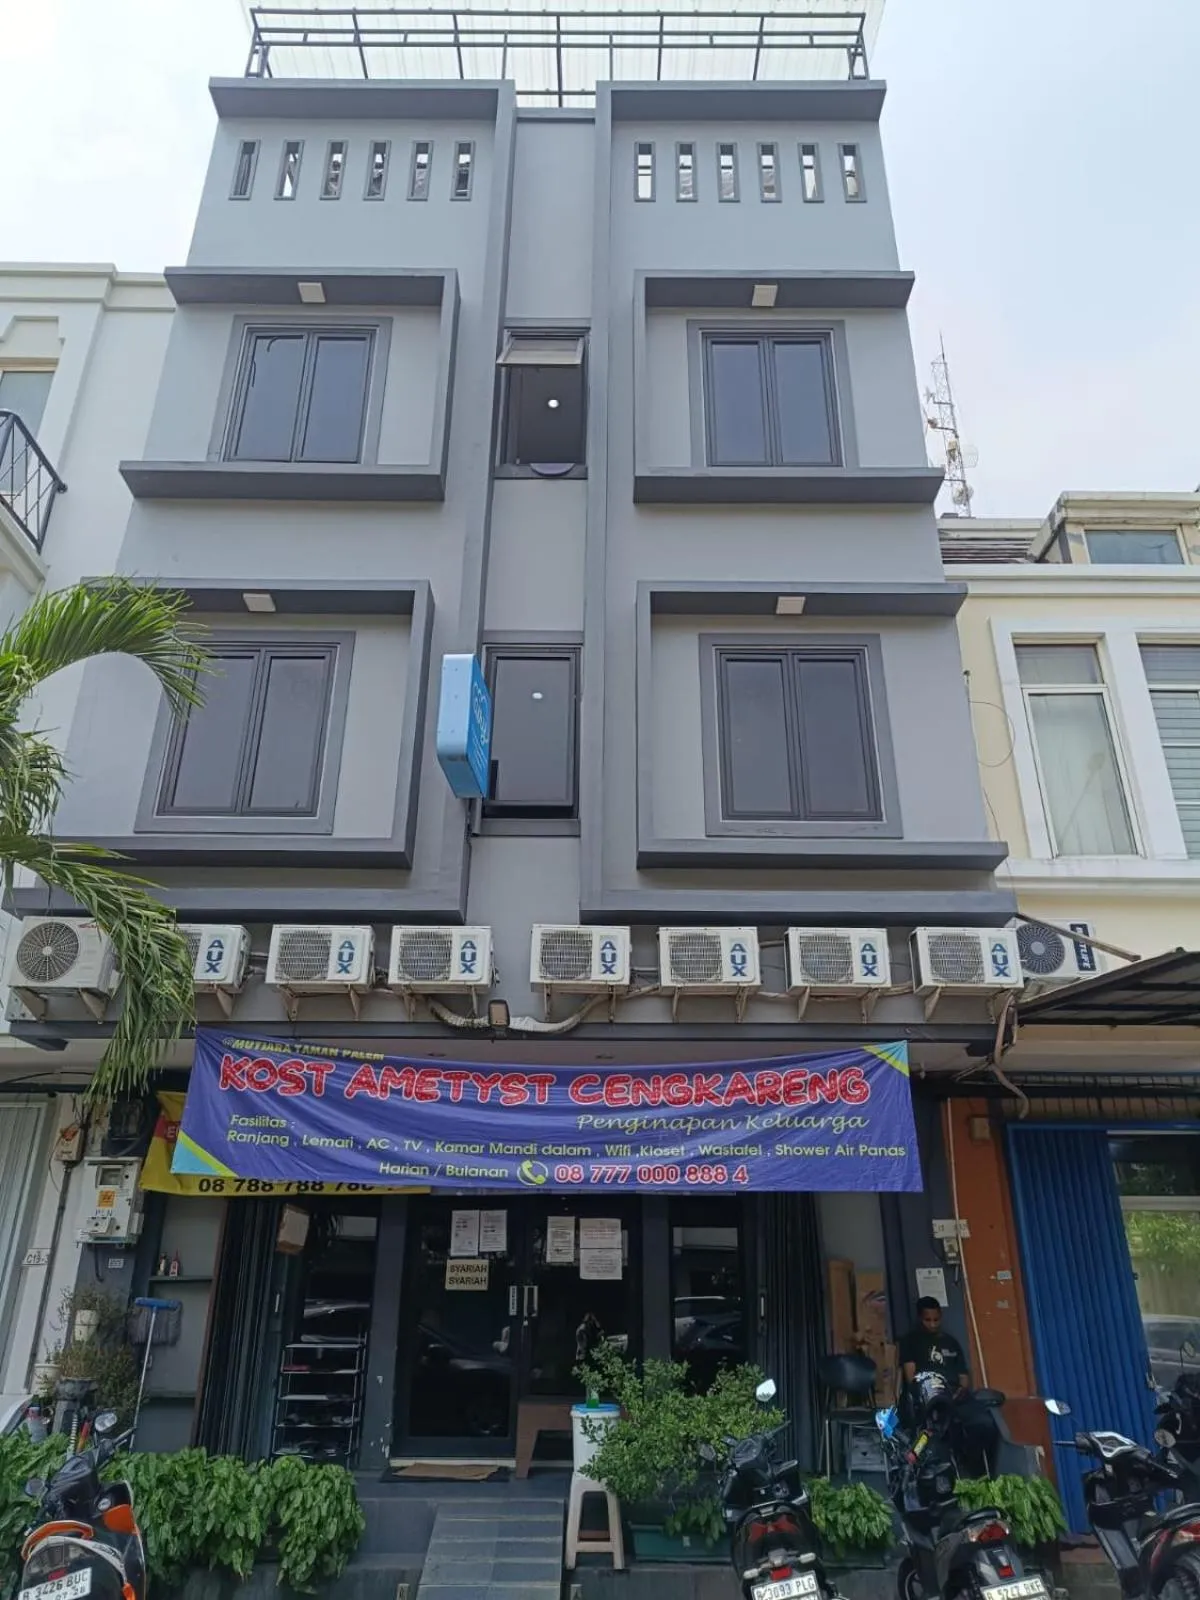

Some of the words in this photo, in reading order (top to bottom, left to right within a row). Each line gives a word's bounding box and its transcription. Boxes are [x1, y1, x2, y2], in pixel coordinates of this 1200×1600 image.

[204, 939, 225, 973] AUX
[337, 939, 354, 975] AUX
[459, 939, 477, 975] AUX
[600, 939, 617, 977] AUX
[729, 941, 749, 977] AUX
[859, 942, 879, 978] AUX
[992, 942, 1012, 979] AUX
[219, 1054, 336, 1097] KOST
[344, 1063, 557, 1106] AMETYST
[568, 1067, 871, 1107] CENGKARENG
[230, 1114, 287, 1129] Fasilitas
[576, 1113, 739, 1136] Penginapan
[745, 1112, 870, 1135] Keluarga
[227, 1129, 290, 1148] Ranjang
[302, 1133, 354, 1149] Lemari
[366, 1138, 390, 1150] AC
[404, 1140, 423, 1151] TV
[434, 1140, 485, 1154] Kamar
[489, 1143, 538, 1155] Mandi
[541, 1144, 592, 1156] dalam
[699, 1143, 762, 1157] Wastafel
[775, 1143, 830, 1157] Shower
[834, 1143, 855, 1157] Air
[858, 1144, 906, 1157] Panas
[199, 1178, 225, 1193] 08
[233, 1179, 274, 1193] 788
[379, 1161, 430, 1176] Harian
[446, 1164, 509, 1178] Bulanan
[554, 1164, 584, 1183] 08
[590, 1164, 632, 1184] 777
[637, 1164, 680, 1184] 000
[685, 1164, 728, 1184] 888
[732, 1164, 750, 1184] 4
